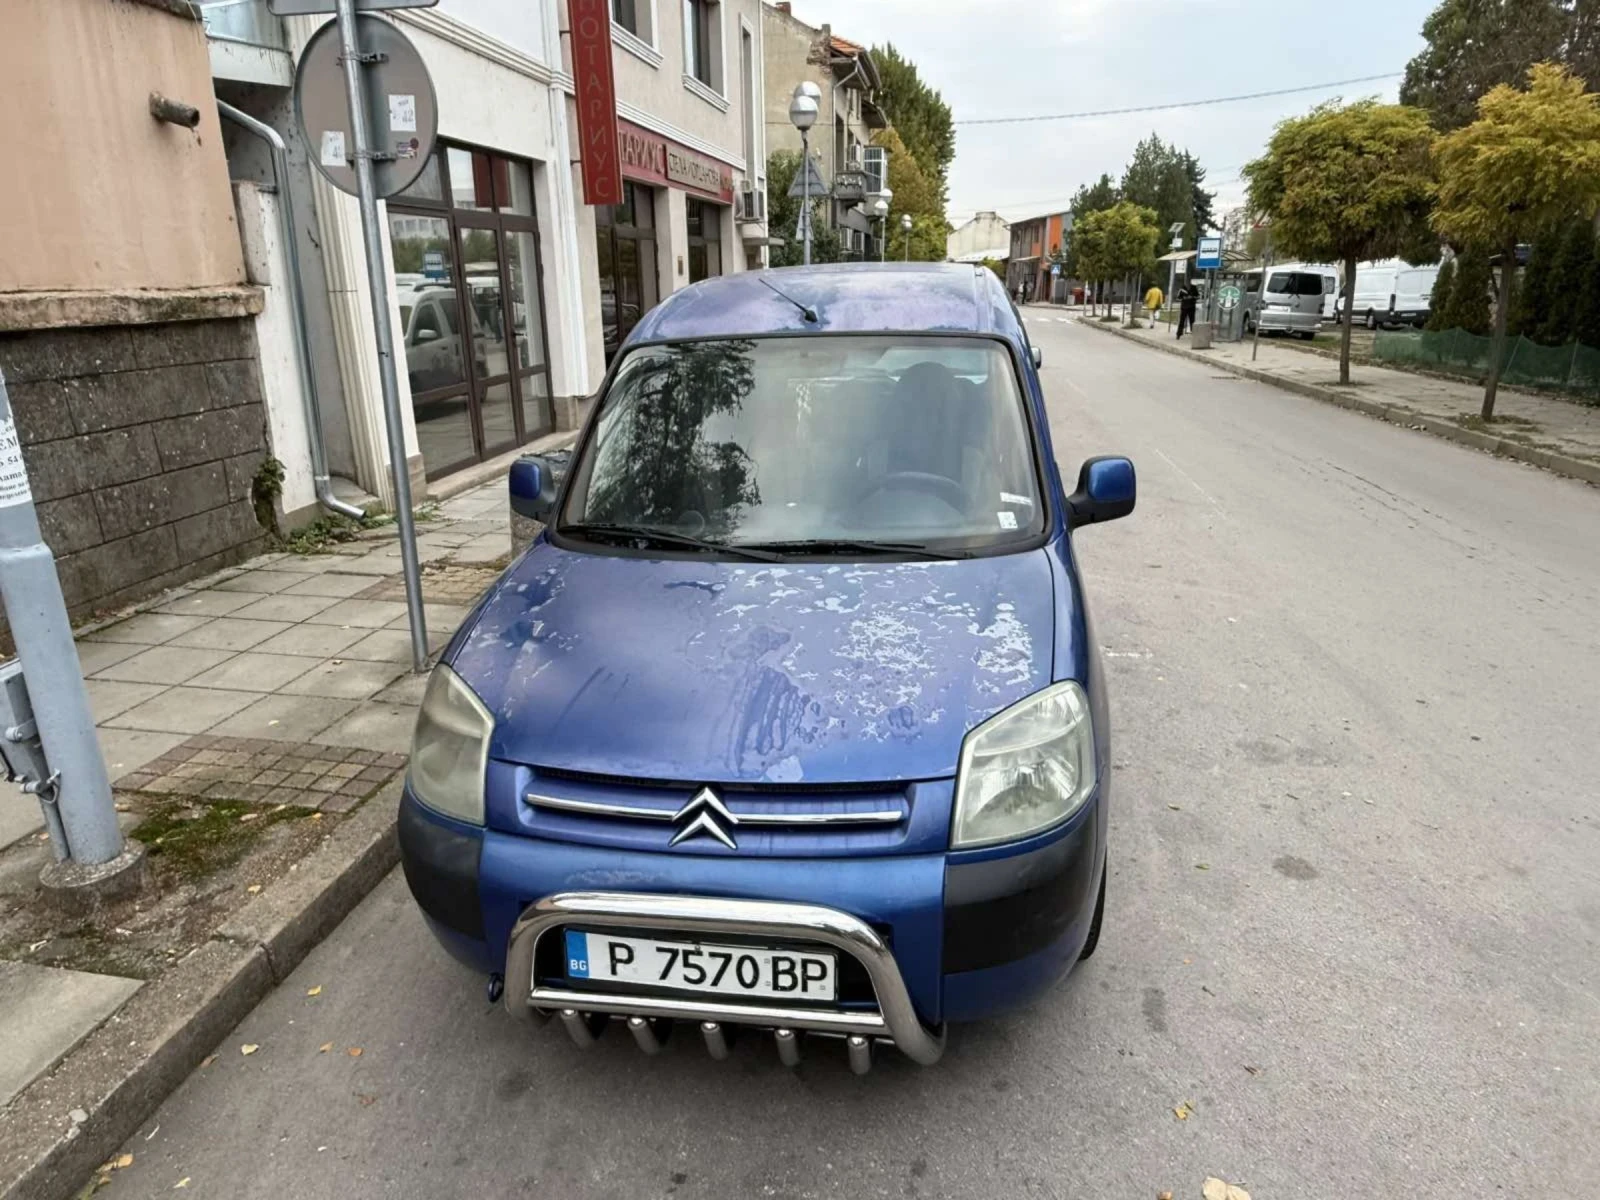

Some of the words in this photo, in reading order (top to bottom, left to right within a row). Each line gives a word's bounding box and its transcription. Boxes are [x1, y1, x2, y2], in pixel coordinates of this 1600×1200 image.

[618, 130, 665, 174] ТАРИУС
[570, 959, 588, 971] BG
[608, 941, 635, 976] P
[655, 946, 760, 990] 7570
[771, 955, 828, 993] BP
